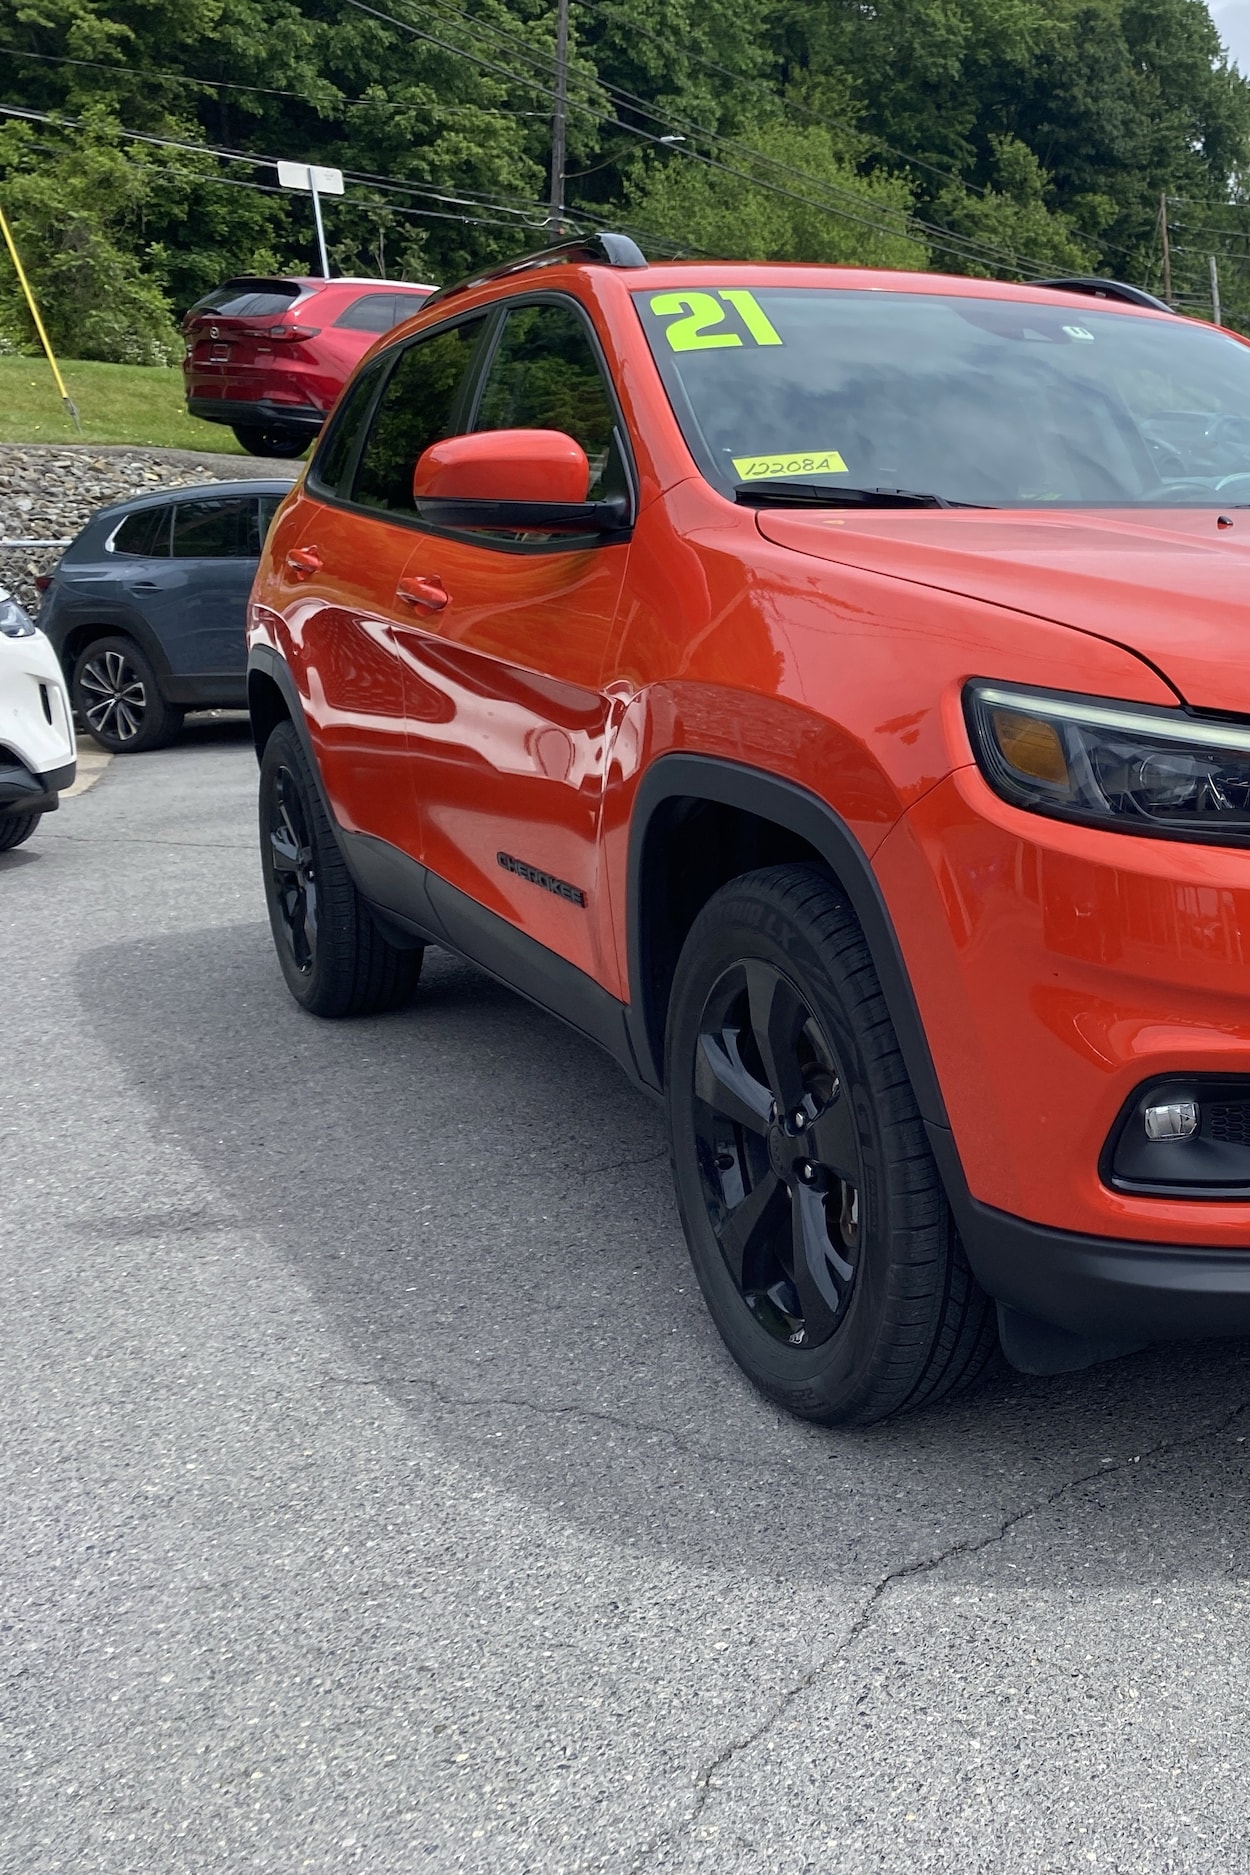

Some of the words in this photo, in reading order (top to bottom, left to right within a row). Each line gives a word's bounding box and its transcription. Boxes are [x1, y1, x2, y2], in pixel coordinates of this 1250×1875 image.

[650, 290, 783, 352] 21
[745, 458, 832, 476] 12208A
[497, 851, 588, 909] CHEROKEE
